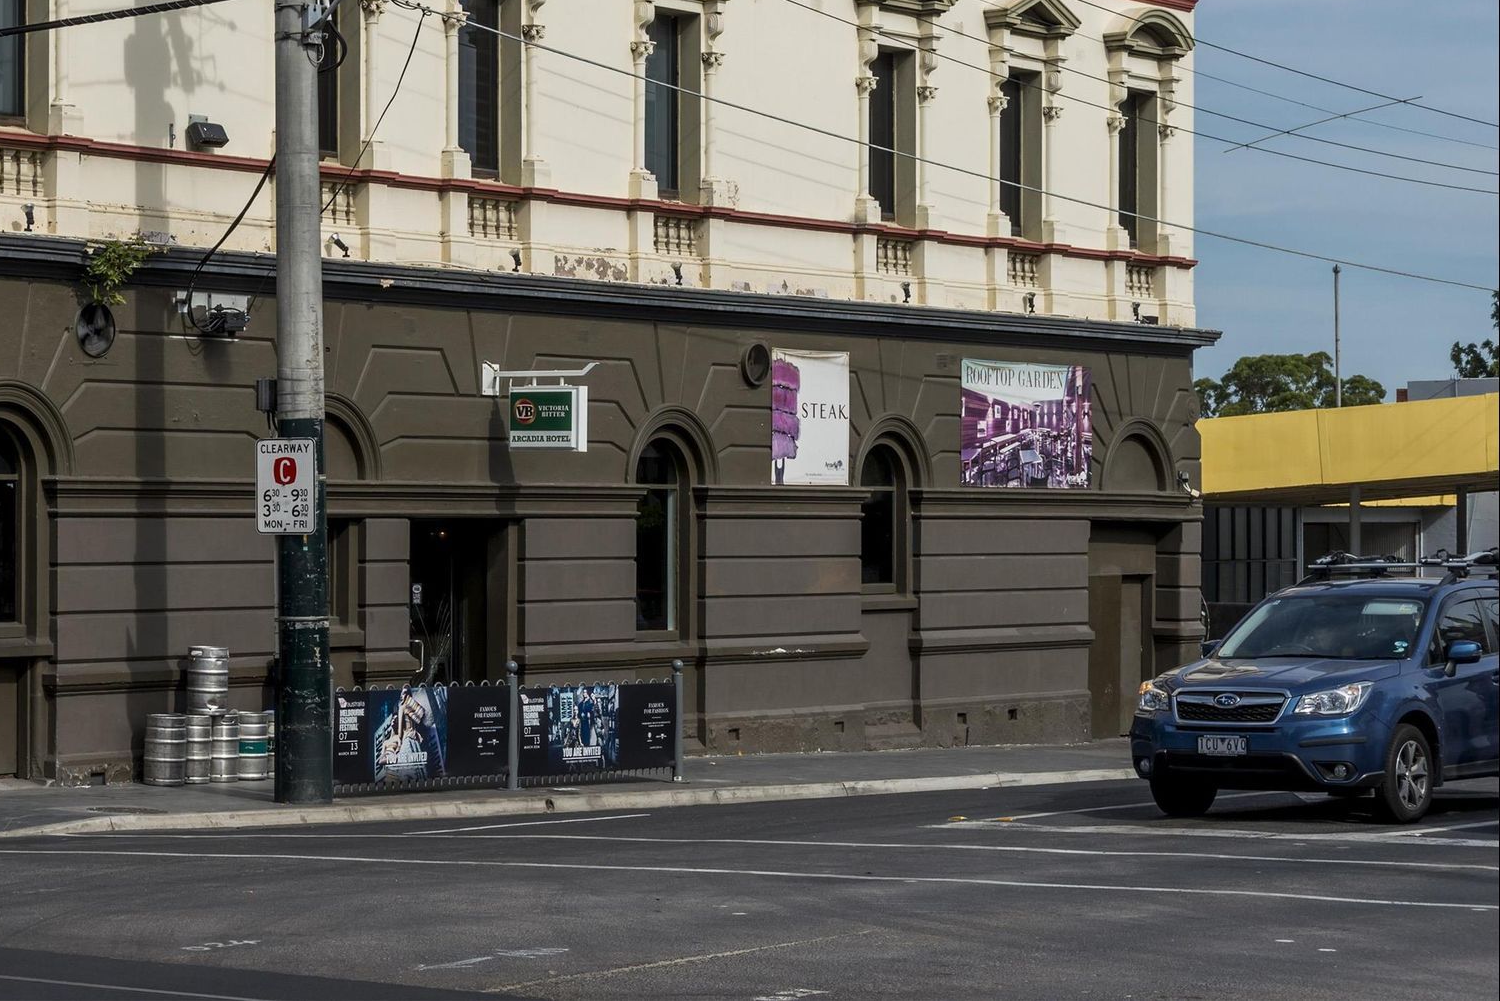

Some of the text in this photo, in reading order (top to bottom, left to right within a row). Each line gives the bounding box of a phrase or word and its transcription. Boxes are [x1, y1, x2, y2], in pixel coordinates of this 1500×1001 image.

[966, 365, 1064, 390] ROOFTOP GARDEN
[516, 405, 533, 417] VB
[801, 402, 848, 420] STEAK
[260, 444, 310, 454] CLEARWAY
[279, 459, 291, 483] C
[264, 520, 283, 528] MON
[293, 520, 308, 528] FRI
[339, 708, 365, 716] MELBOURNE
[339, 723, 359, 731] FESTIVAL
[523, 727, 532, 735] 07
[338, 732, 348, 740] 07
[533, 737, 540, 745] 13
[351, 742, 358, 750] 13
[562, 746, 601, 757] YOU ARE INVITED
[408, 751, 428, 762] INVITED
